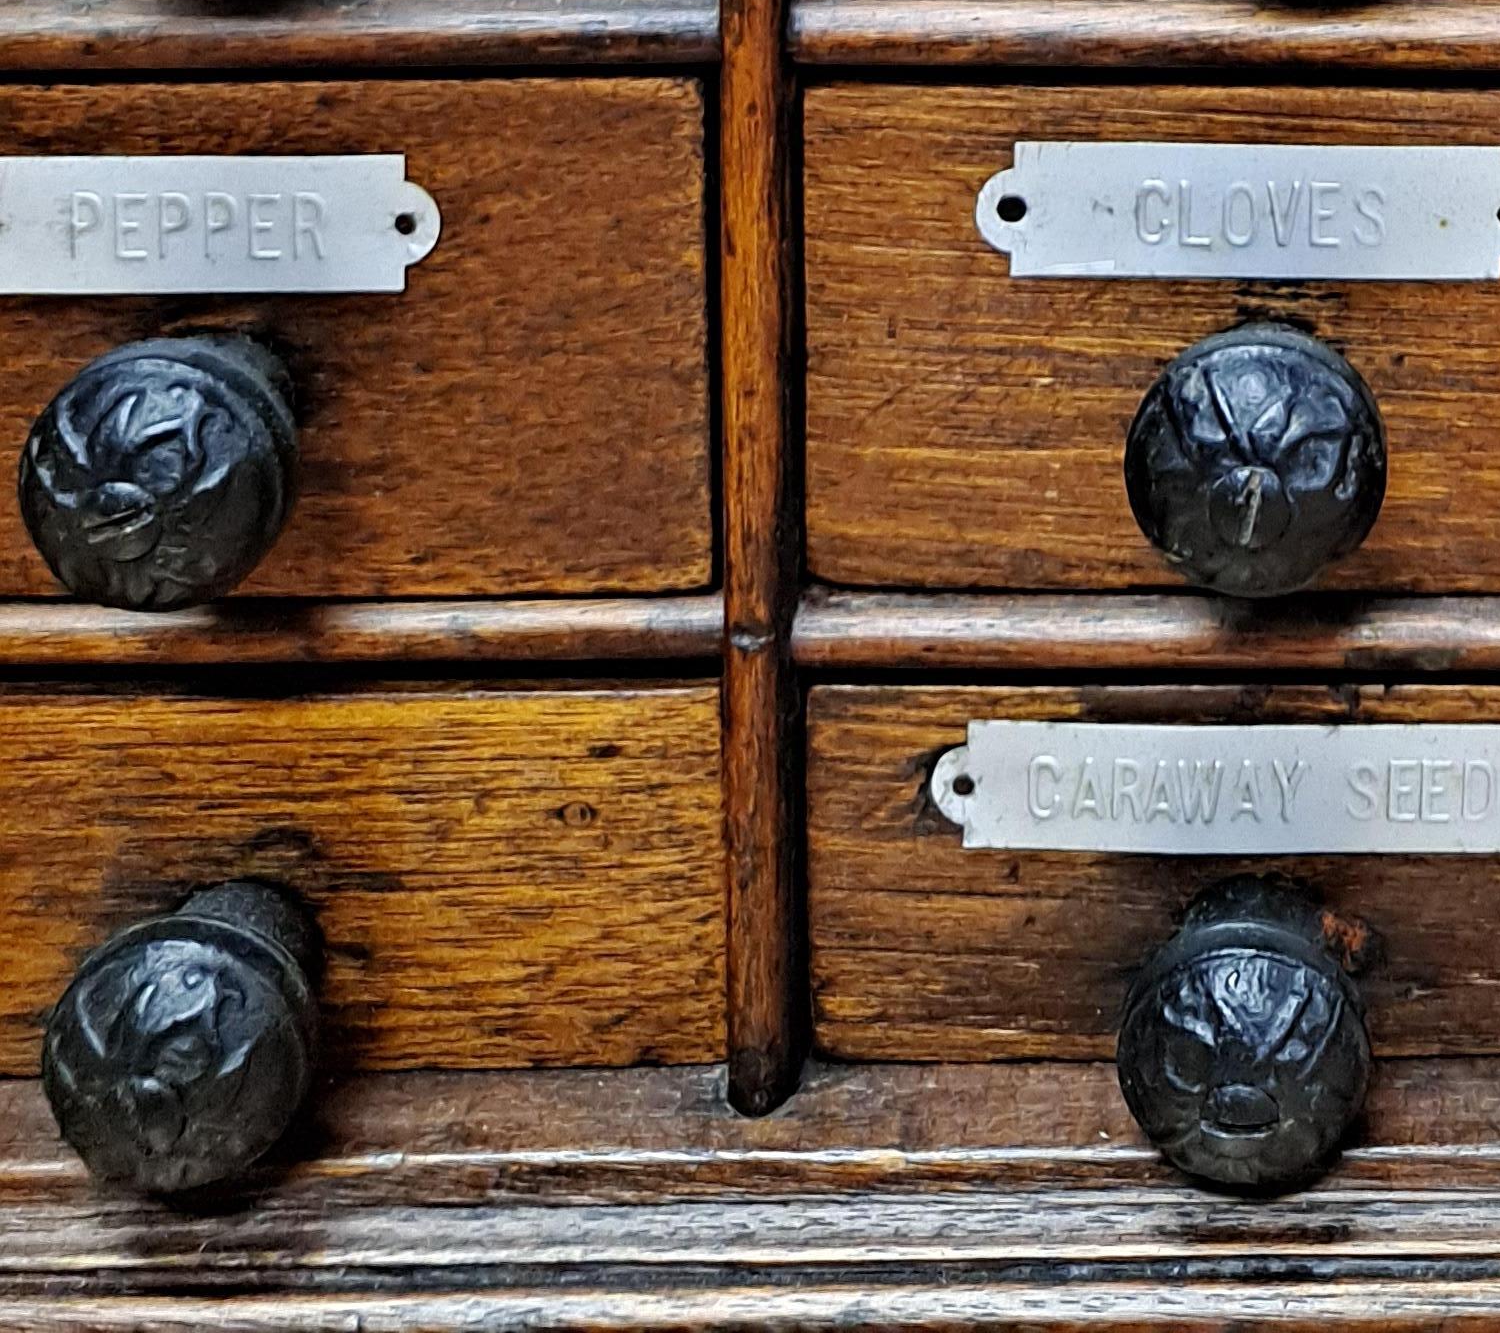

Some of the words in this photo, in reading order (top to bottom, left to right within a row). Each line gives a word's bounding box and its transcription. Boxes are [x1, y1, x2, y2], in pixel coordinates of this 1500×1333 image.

[69, 190, 326, 261] PEPPER
[1133, 178, 1387, 249] CLOVES
[1026, 754, 1307, 824] CARAWAY
[1344, 759, 1500, 823] SEED
